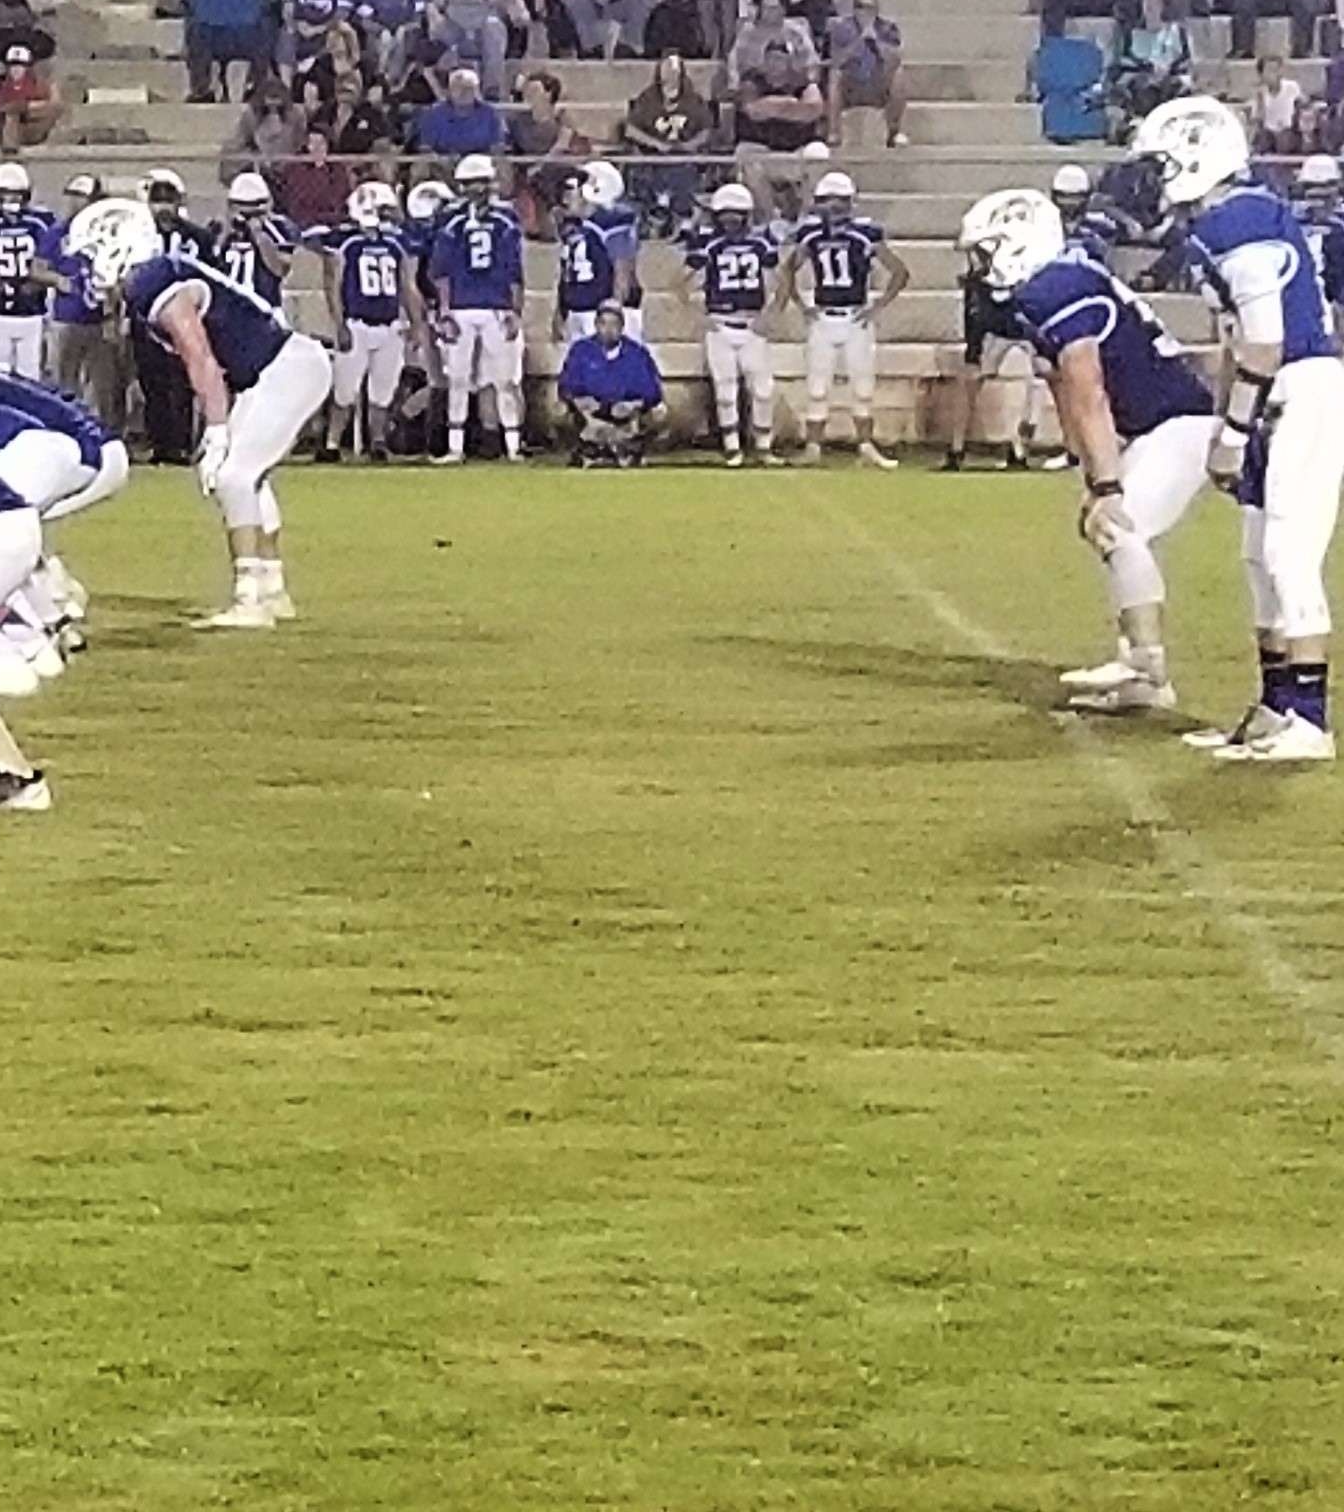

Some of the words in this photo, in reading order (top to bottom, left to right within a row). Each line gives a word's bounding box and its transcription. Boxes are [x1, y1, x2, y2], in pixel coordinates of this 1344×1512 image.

[469, 230, 492, 269] 2
[818, 248, 853, 287] 11
[358, 255, 397, 296] 66
